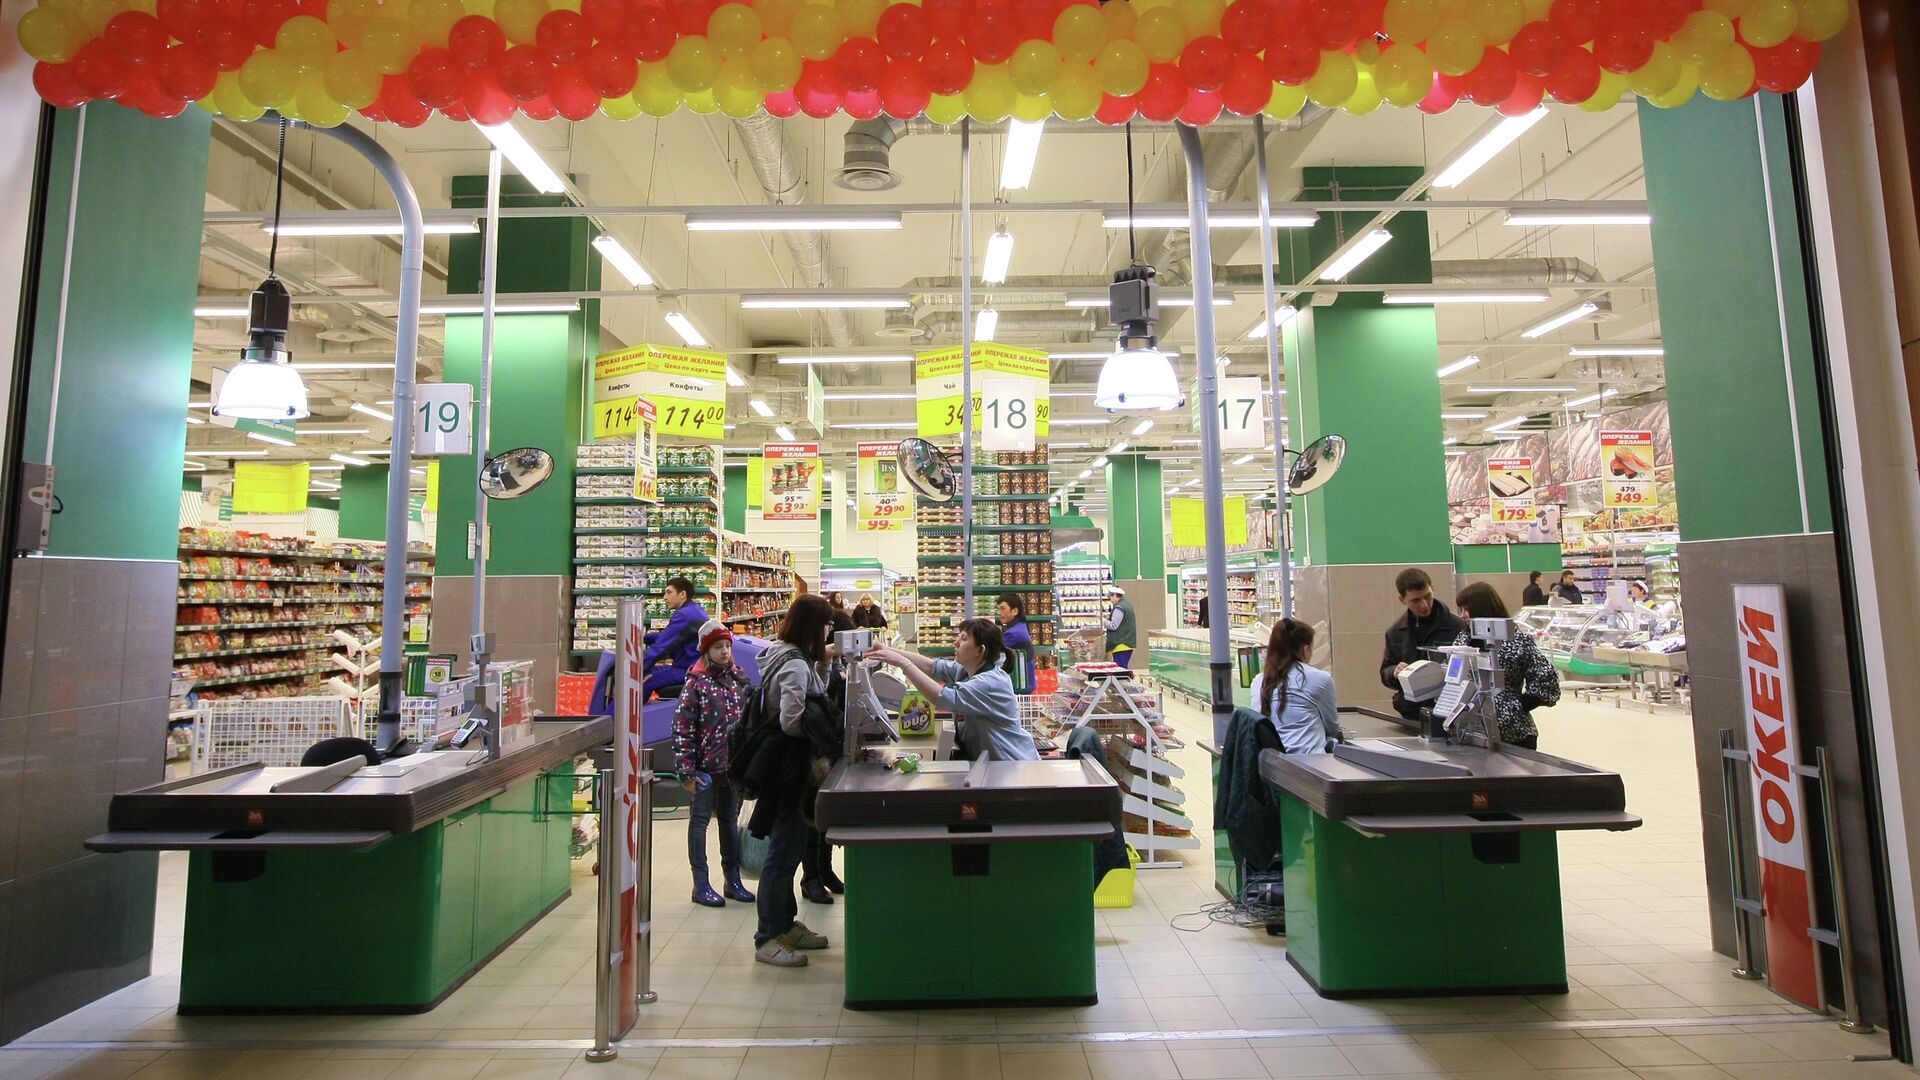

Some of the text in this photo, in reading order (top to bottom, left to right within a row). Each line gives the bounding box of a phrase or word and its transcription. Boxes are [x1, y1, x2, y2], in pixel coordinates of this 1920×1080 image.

[648, 351, 725, 367] ОПЕРЕЖАЯ ЖЕЛАНИЯ
[664, 362, 680, 370] Цена
[670, 382, 704, 392] Конфеты
[944, 382, 956, 390] Чай
[418, 401, 461, 433] 19
[986, 398, 1027, 429] 18
[1218, 398, 1256, 430] 17
[1614, 492, 1649, 503] 349.-
[1498, 508, 1533, 521] 179.-
[903, 714, 928, 729] DUO
